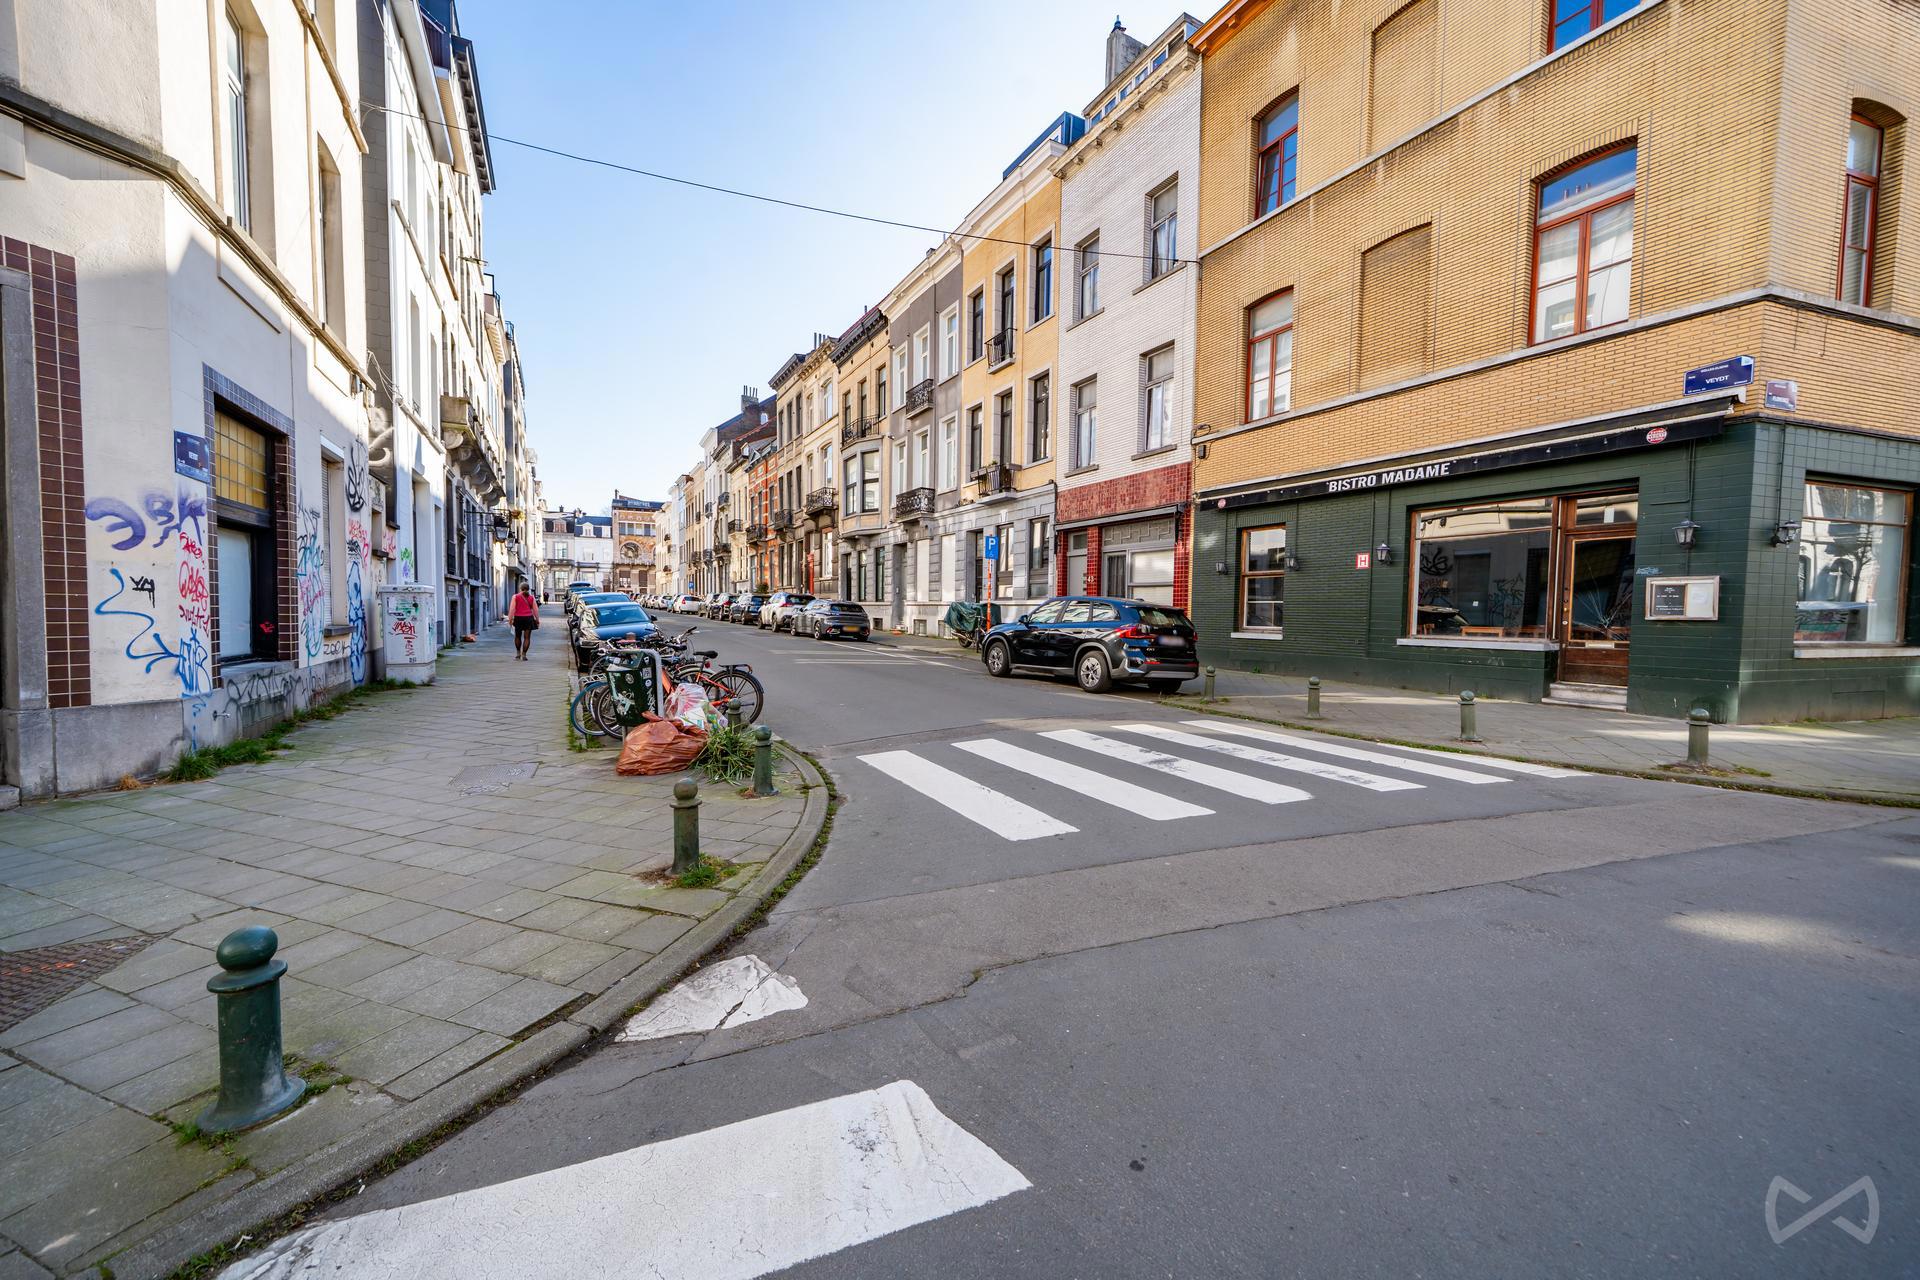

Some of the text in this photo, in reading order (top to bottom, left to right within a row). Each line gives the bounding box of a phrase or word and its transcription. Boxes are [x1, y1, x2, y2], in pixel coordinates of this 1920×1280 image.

[1705, 374, 1730, 384] VEYDT
[1328, 462, 1451, 492] BISTRO MADAME
[988, 537, 996, 550] P
